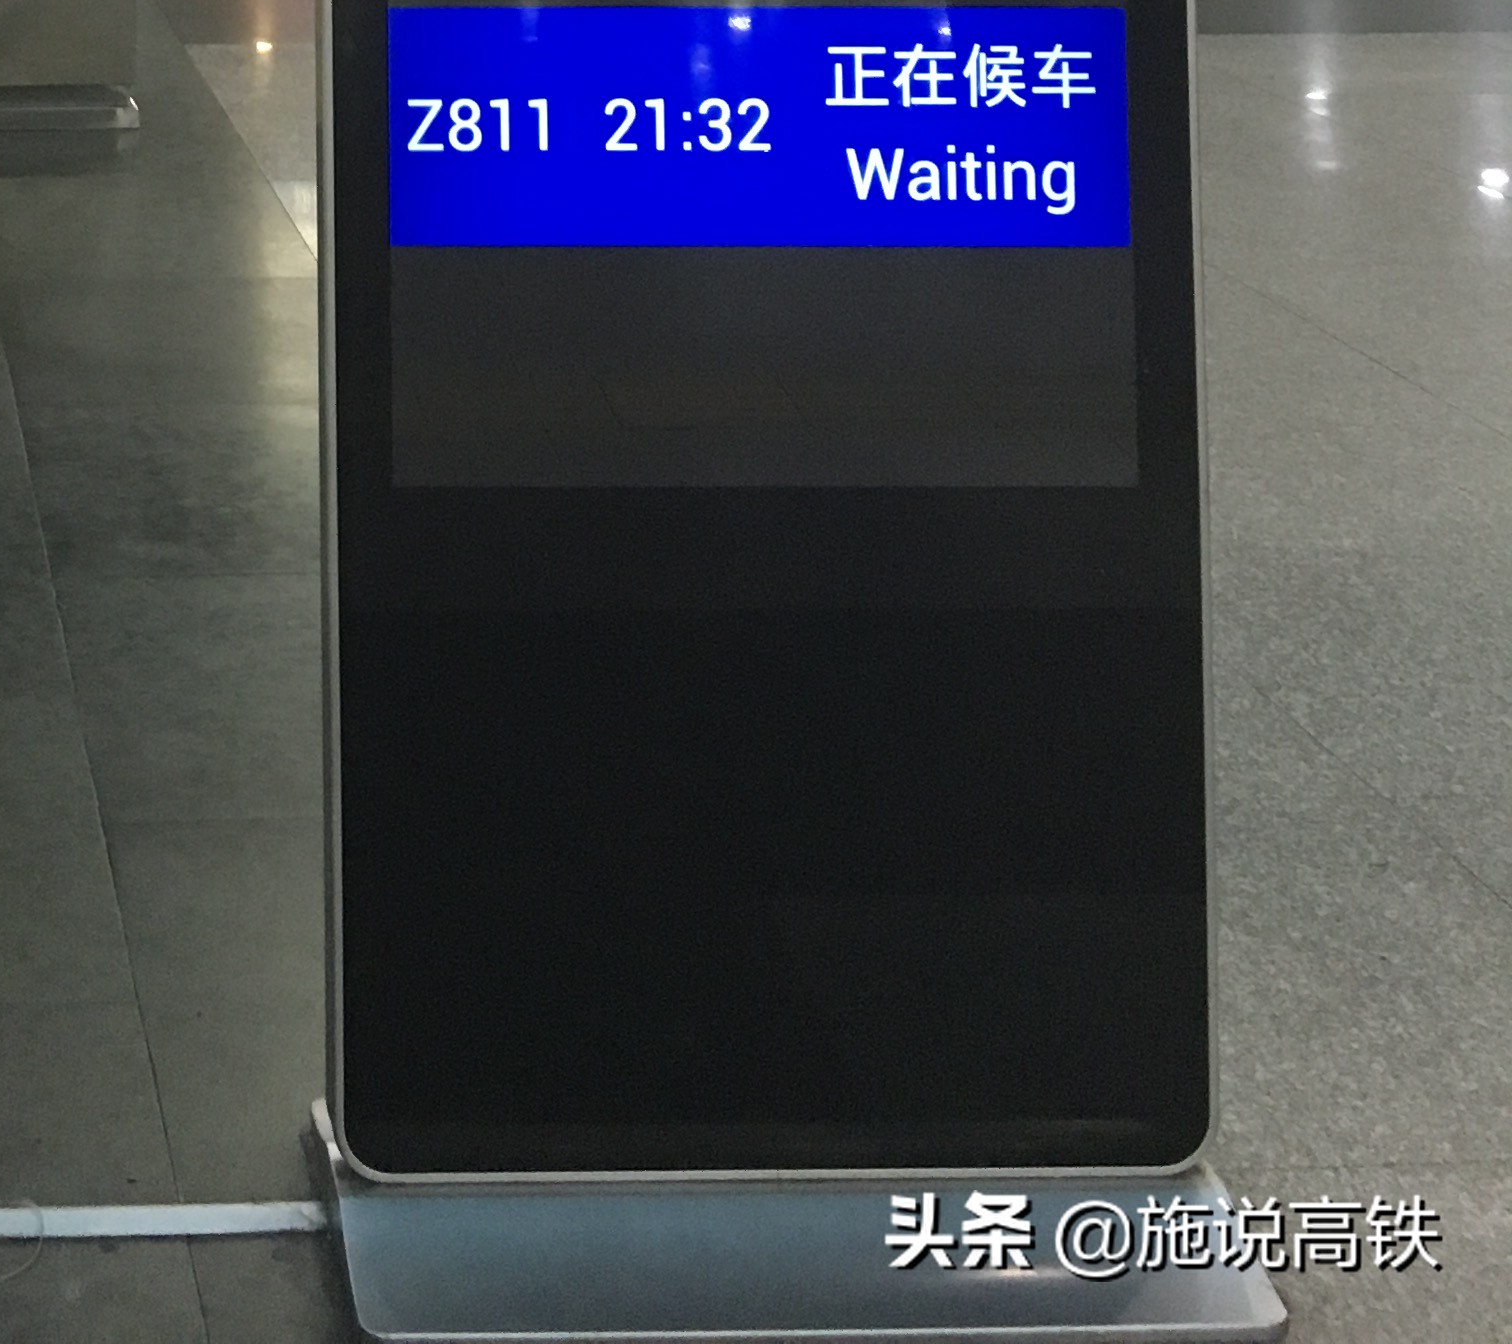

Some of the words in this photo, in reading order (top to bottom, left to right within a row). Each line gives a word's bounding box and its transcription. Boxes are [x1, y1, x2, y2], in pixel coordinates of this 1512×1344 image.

[825, 43, 1097, 109] 正在候车
[407, 98, 550, 152] Z811
[603, 97, 772, 153] 21:32
[846, 144, 1077, 215] Waiting
